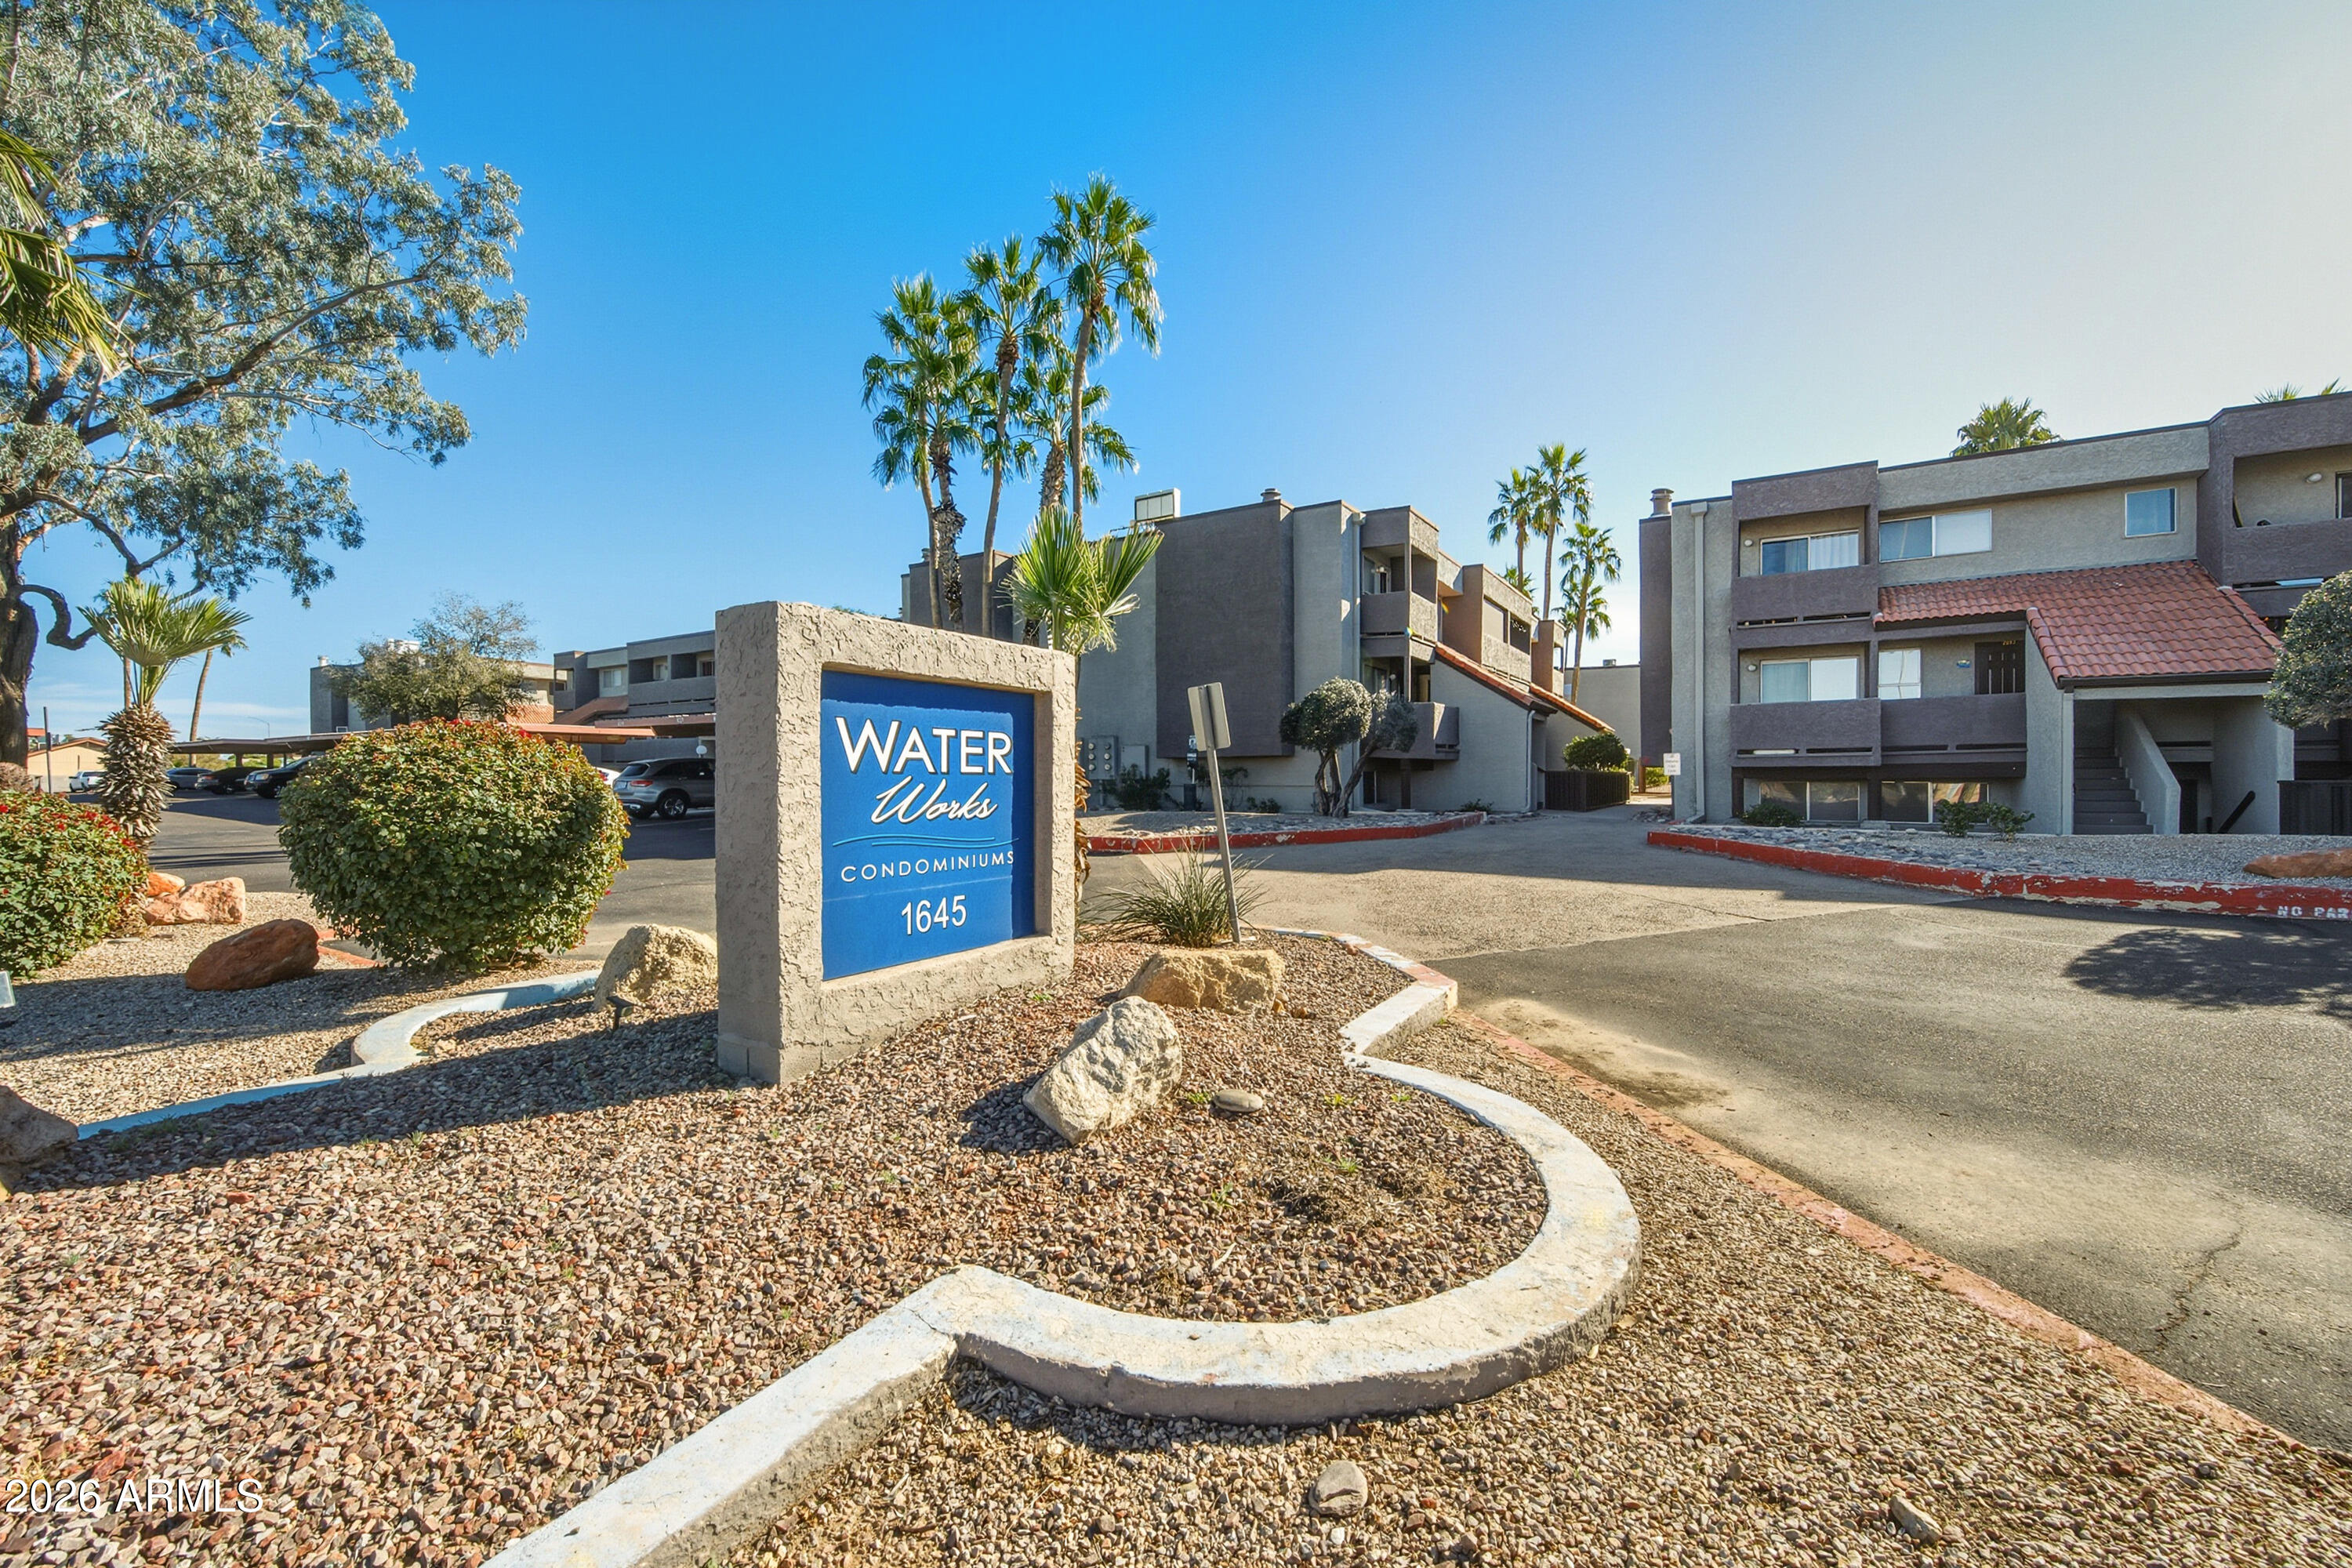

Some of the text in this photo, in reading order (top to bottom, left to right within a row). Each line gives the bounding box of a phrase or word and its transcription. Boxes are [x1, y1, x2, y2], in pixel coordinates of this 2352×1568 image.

[835, 717, 1013, 775] WATER
[870, 775, 998, 823] Works
[840, 851, 1014, 883] CONDOMINIUMS
[902, 895, 967, 935] 1645
[2278, 906, 2352, 919] NO PAR
